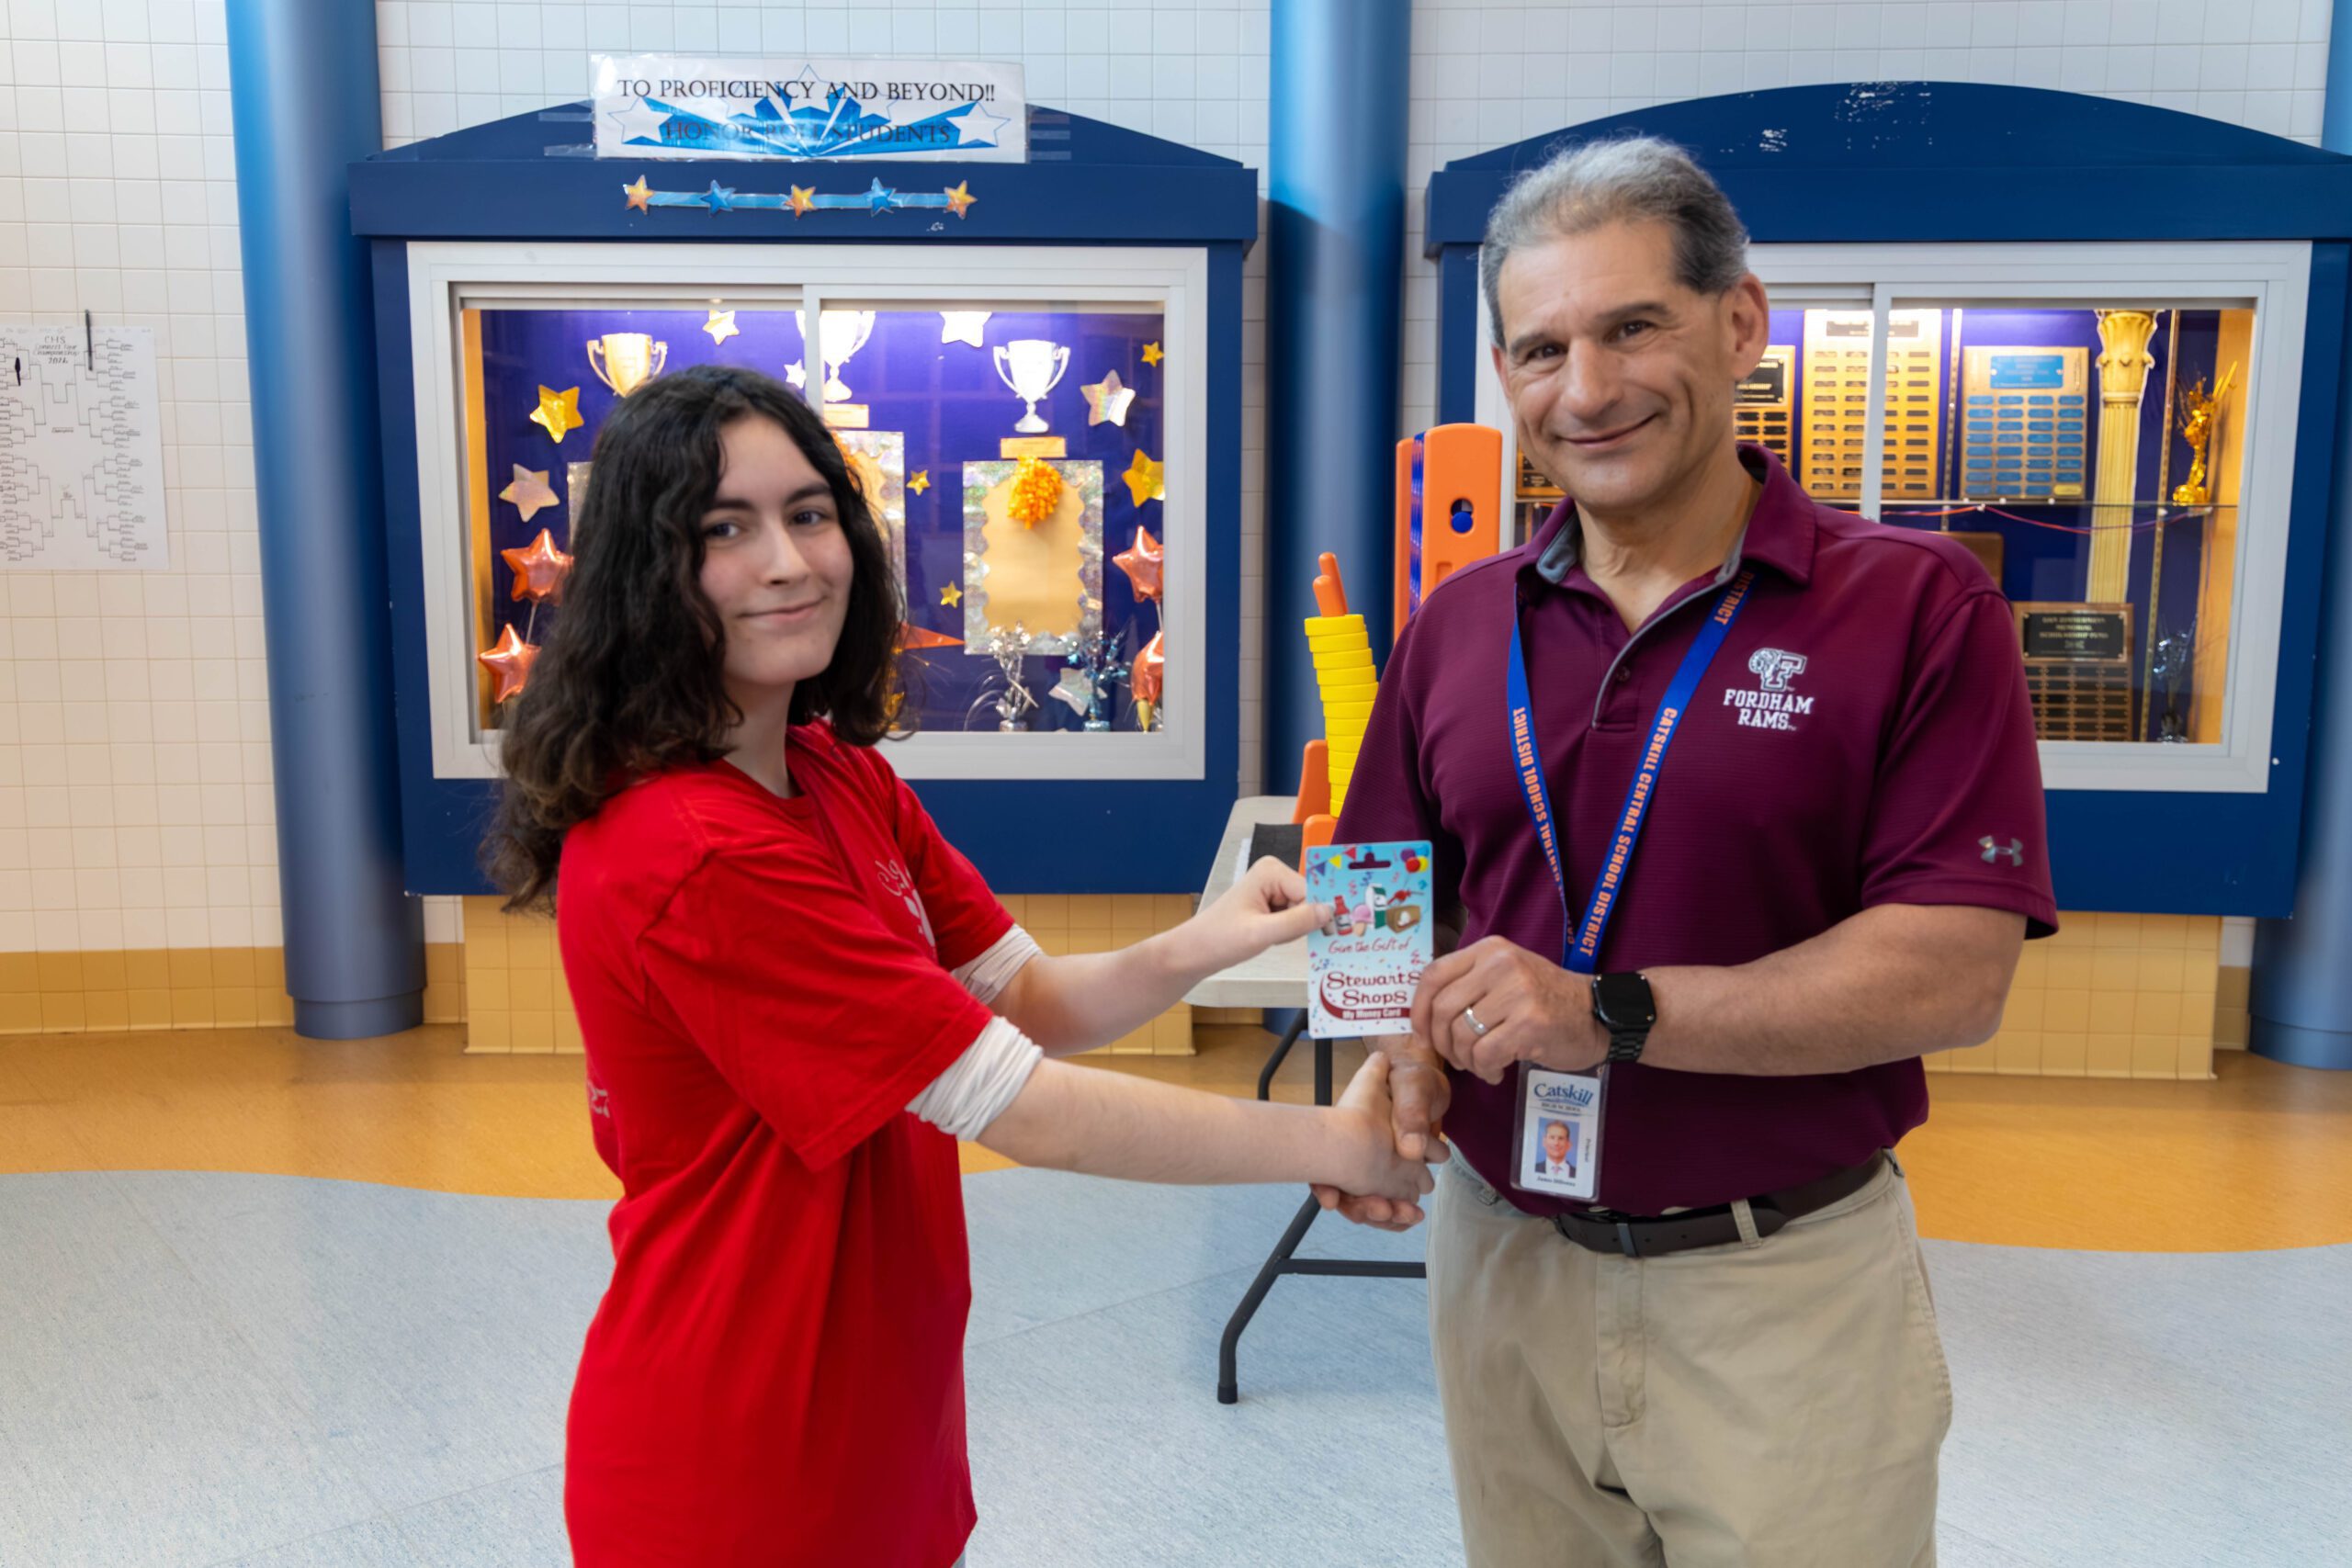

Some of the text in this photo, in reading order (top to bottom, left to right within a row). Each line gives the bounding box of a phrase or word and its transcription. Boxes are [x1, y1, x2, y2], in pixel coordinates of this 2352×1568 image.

[617, 79, 995, 102] TO PROFICIENCY AND BEYOND!!
[665, 120, 752, 140] HONOR
[831, 123, 951, 143] STUDENTS
[1713, 571, 1754, 625] DISTRICT
[1723, 688, 1815, 715] FORDHAM
[1737, 707, 1791, 730] RAMS
[1512, 706, 1535, 768] DISTRICT
[1522, 766, 1547, 822] SCHOOL
[1579, 707, 1678, 957] CATSKILL CENTRAL SCHOOL DISTRICT
[1329, 940, 1352, 954] Give
[1355, 941, 1370, 953] the
[1372, 937, 1397, 952] Gift
[1533, 1083, 1594, 1105] Catskill
